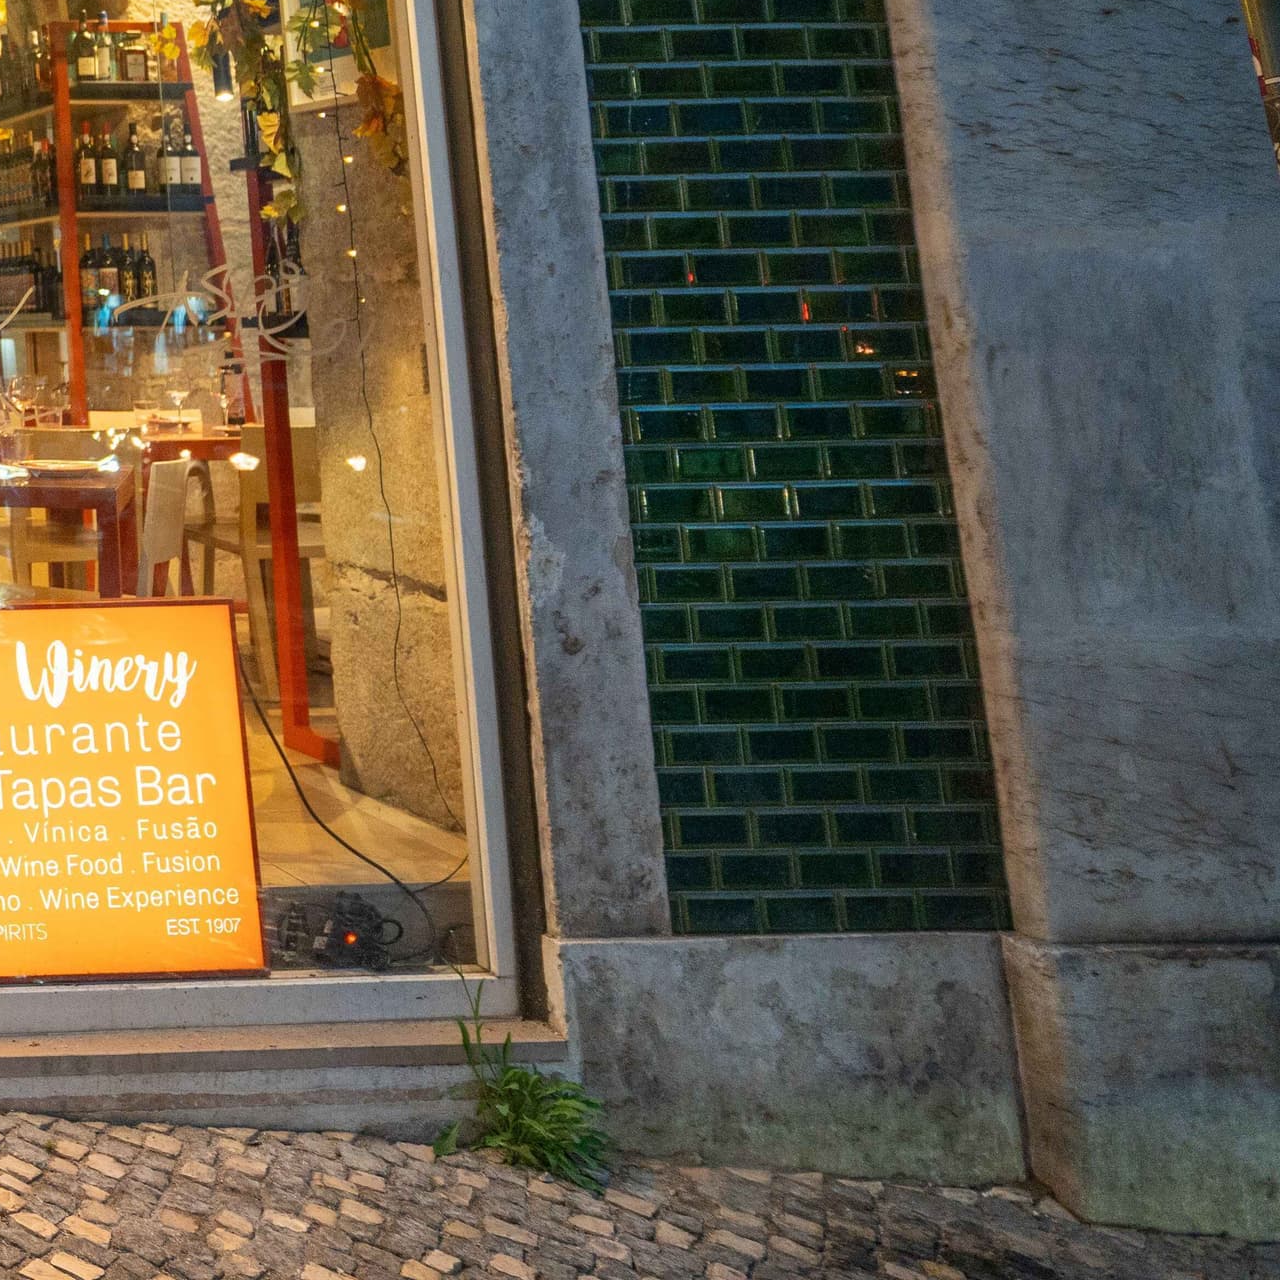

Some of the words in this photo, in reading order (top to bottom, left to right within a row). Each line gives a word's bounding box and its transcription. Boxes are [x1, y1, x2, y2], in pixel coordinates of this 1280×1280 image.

[15, 639, 197, 708] Winery
[134, 765, 217, 807] Bar
[23, 820, 109, 845] Vínica
[136, 816, 218, 840] Fusão
[0, 856, 59, 878] Wine
[66, 853, 124, 876] Food
[141, 849, 221, 874] Fusion
[39, 888, 100, 910] Wine
[106, 885, 240, 913] Experience
[205, 916, 241, 935] 1907
